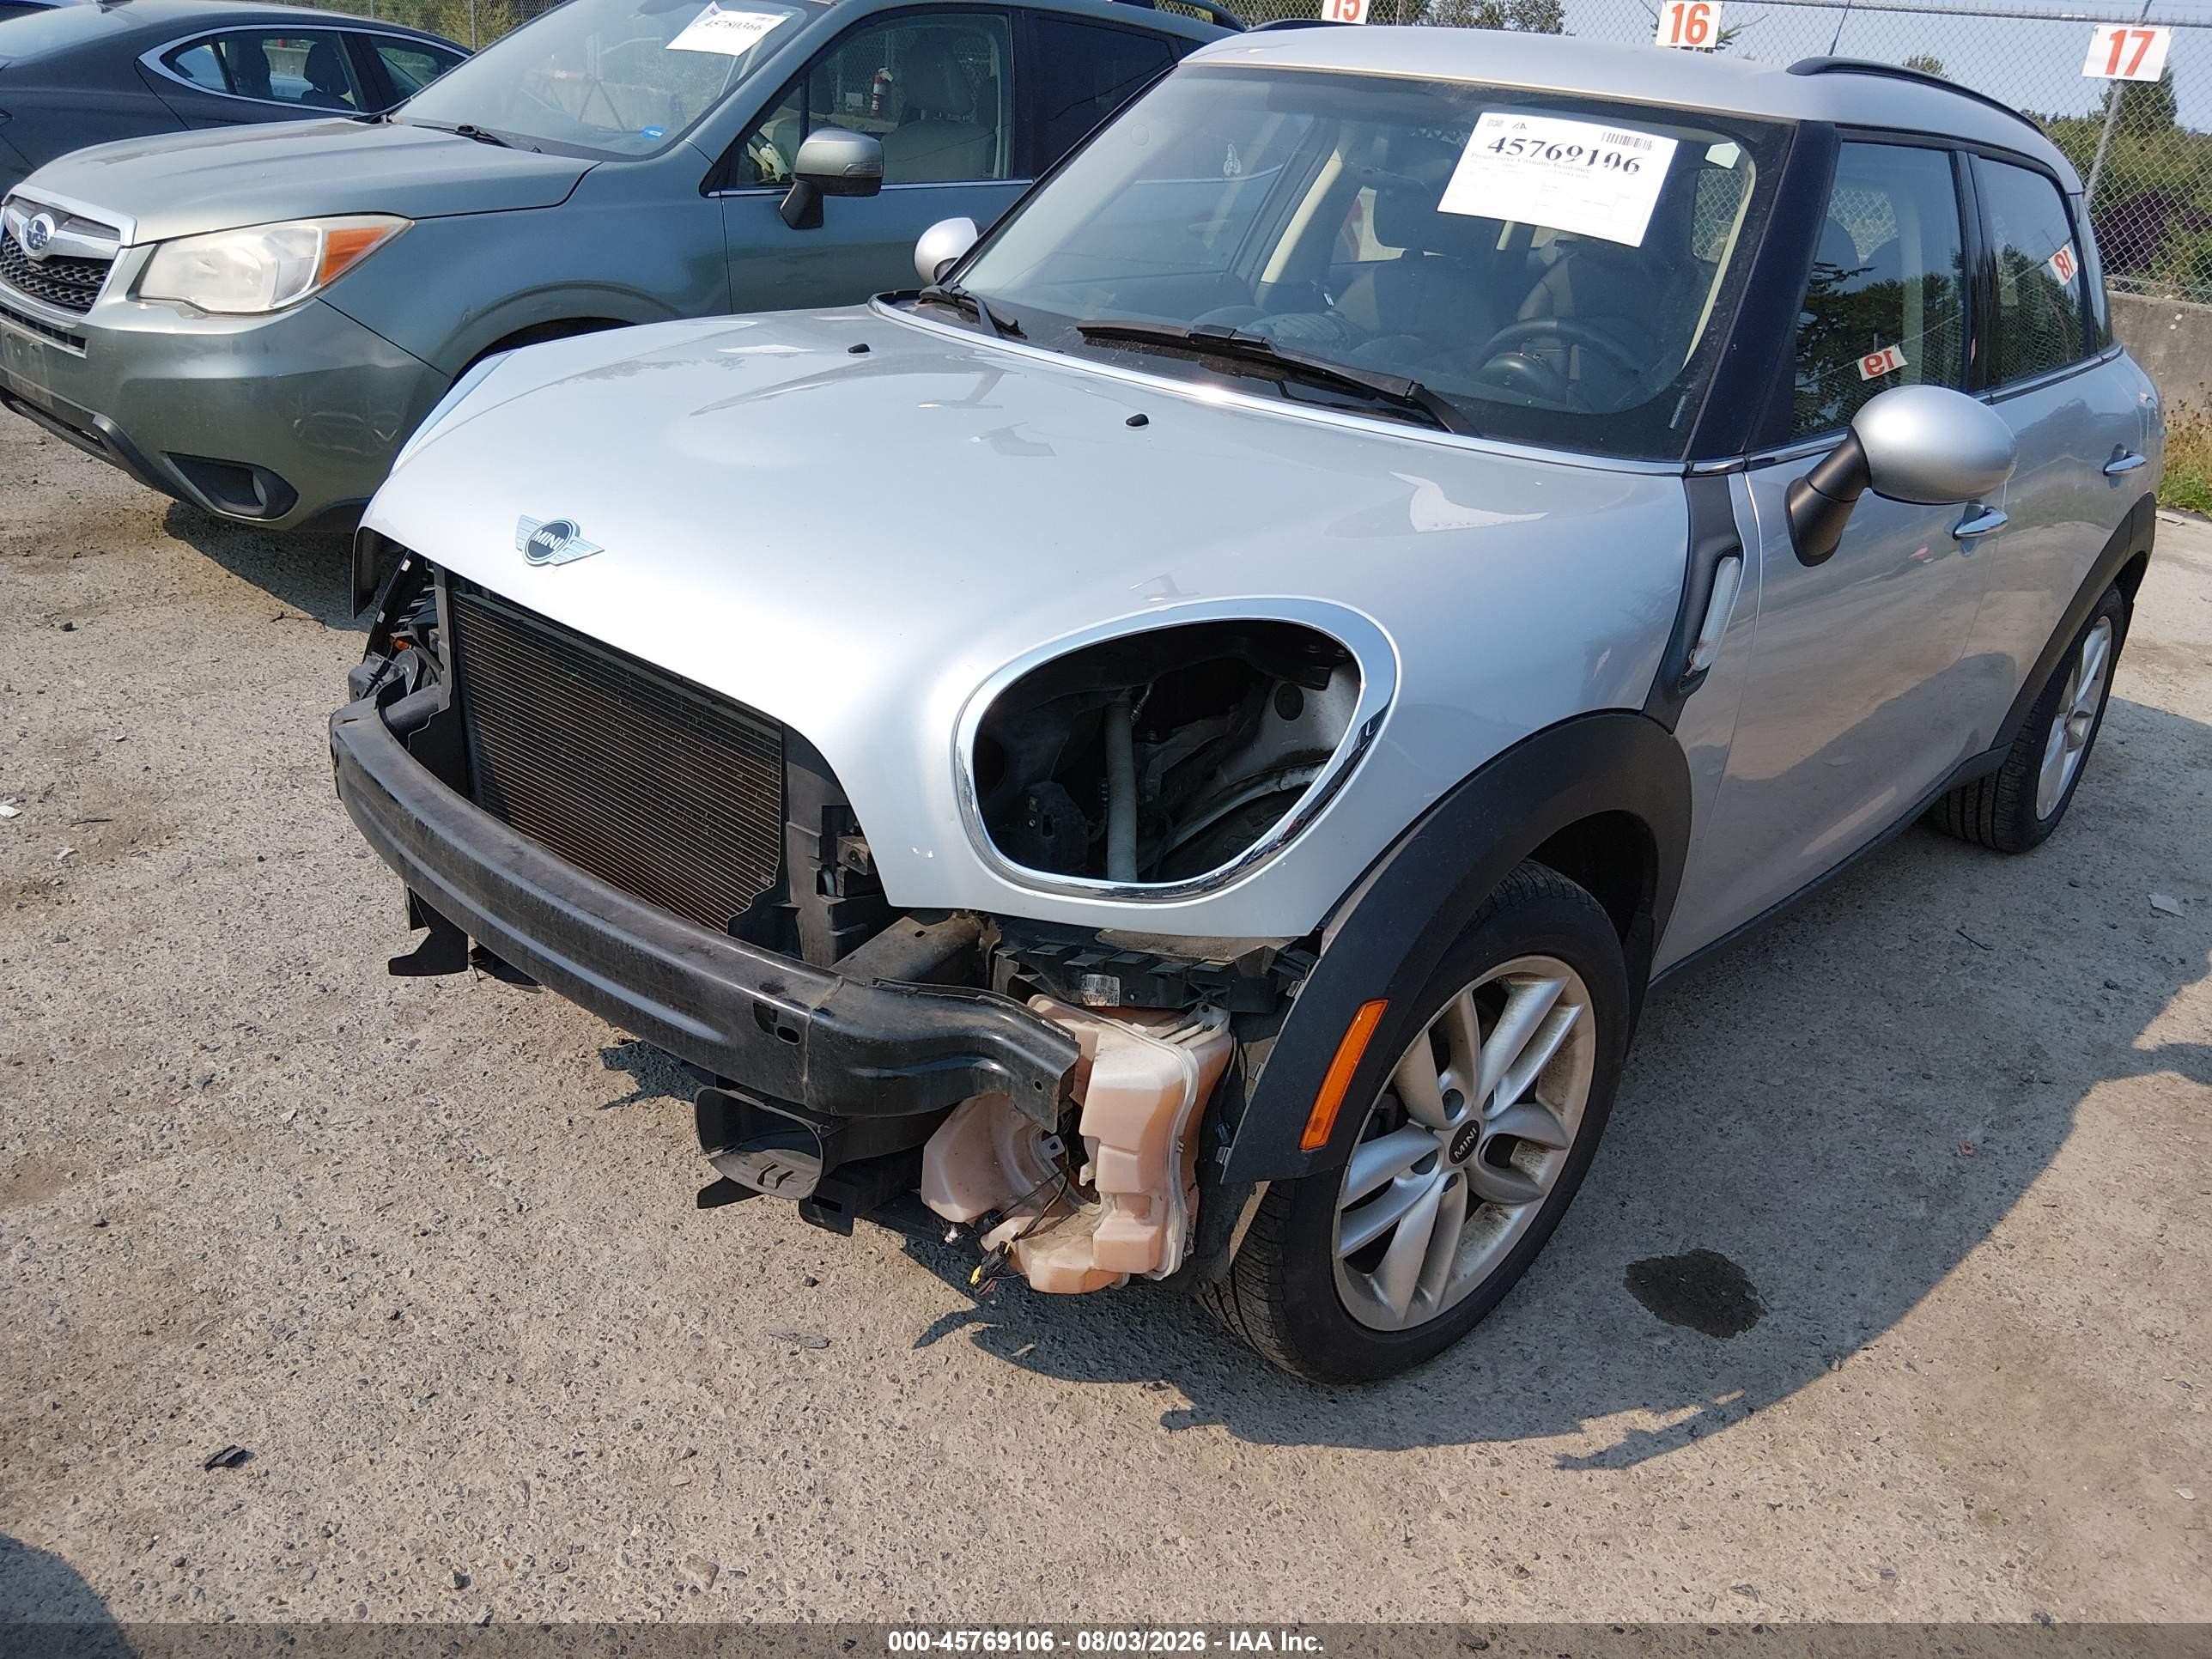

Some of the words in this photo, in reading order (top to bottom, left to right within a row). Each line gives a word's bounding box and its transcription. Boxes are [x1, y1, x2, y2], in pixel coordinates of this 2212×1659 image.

[1670, 3, 1710, 45] 16
[2105, 29, 2156, 76] 17
[1487, 137, 1644, 175] 45769106
[532, 529, 565, 550] MINI
[1454, 1127, 1477, 1158] MINI
